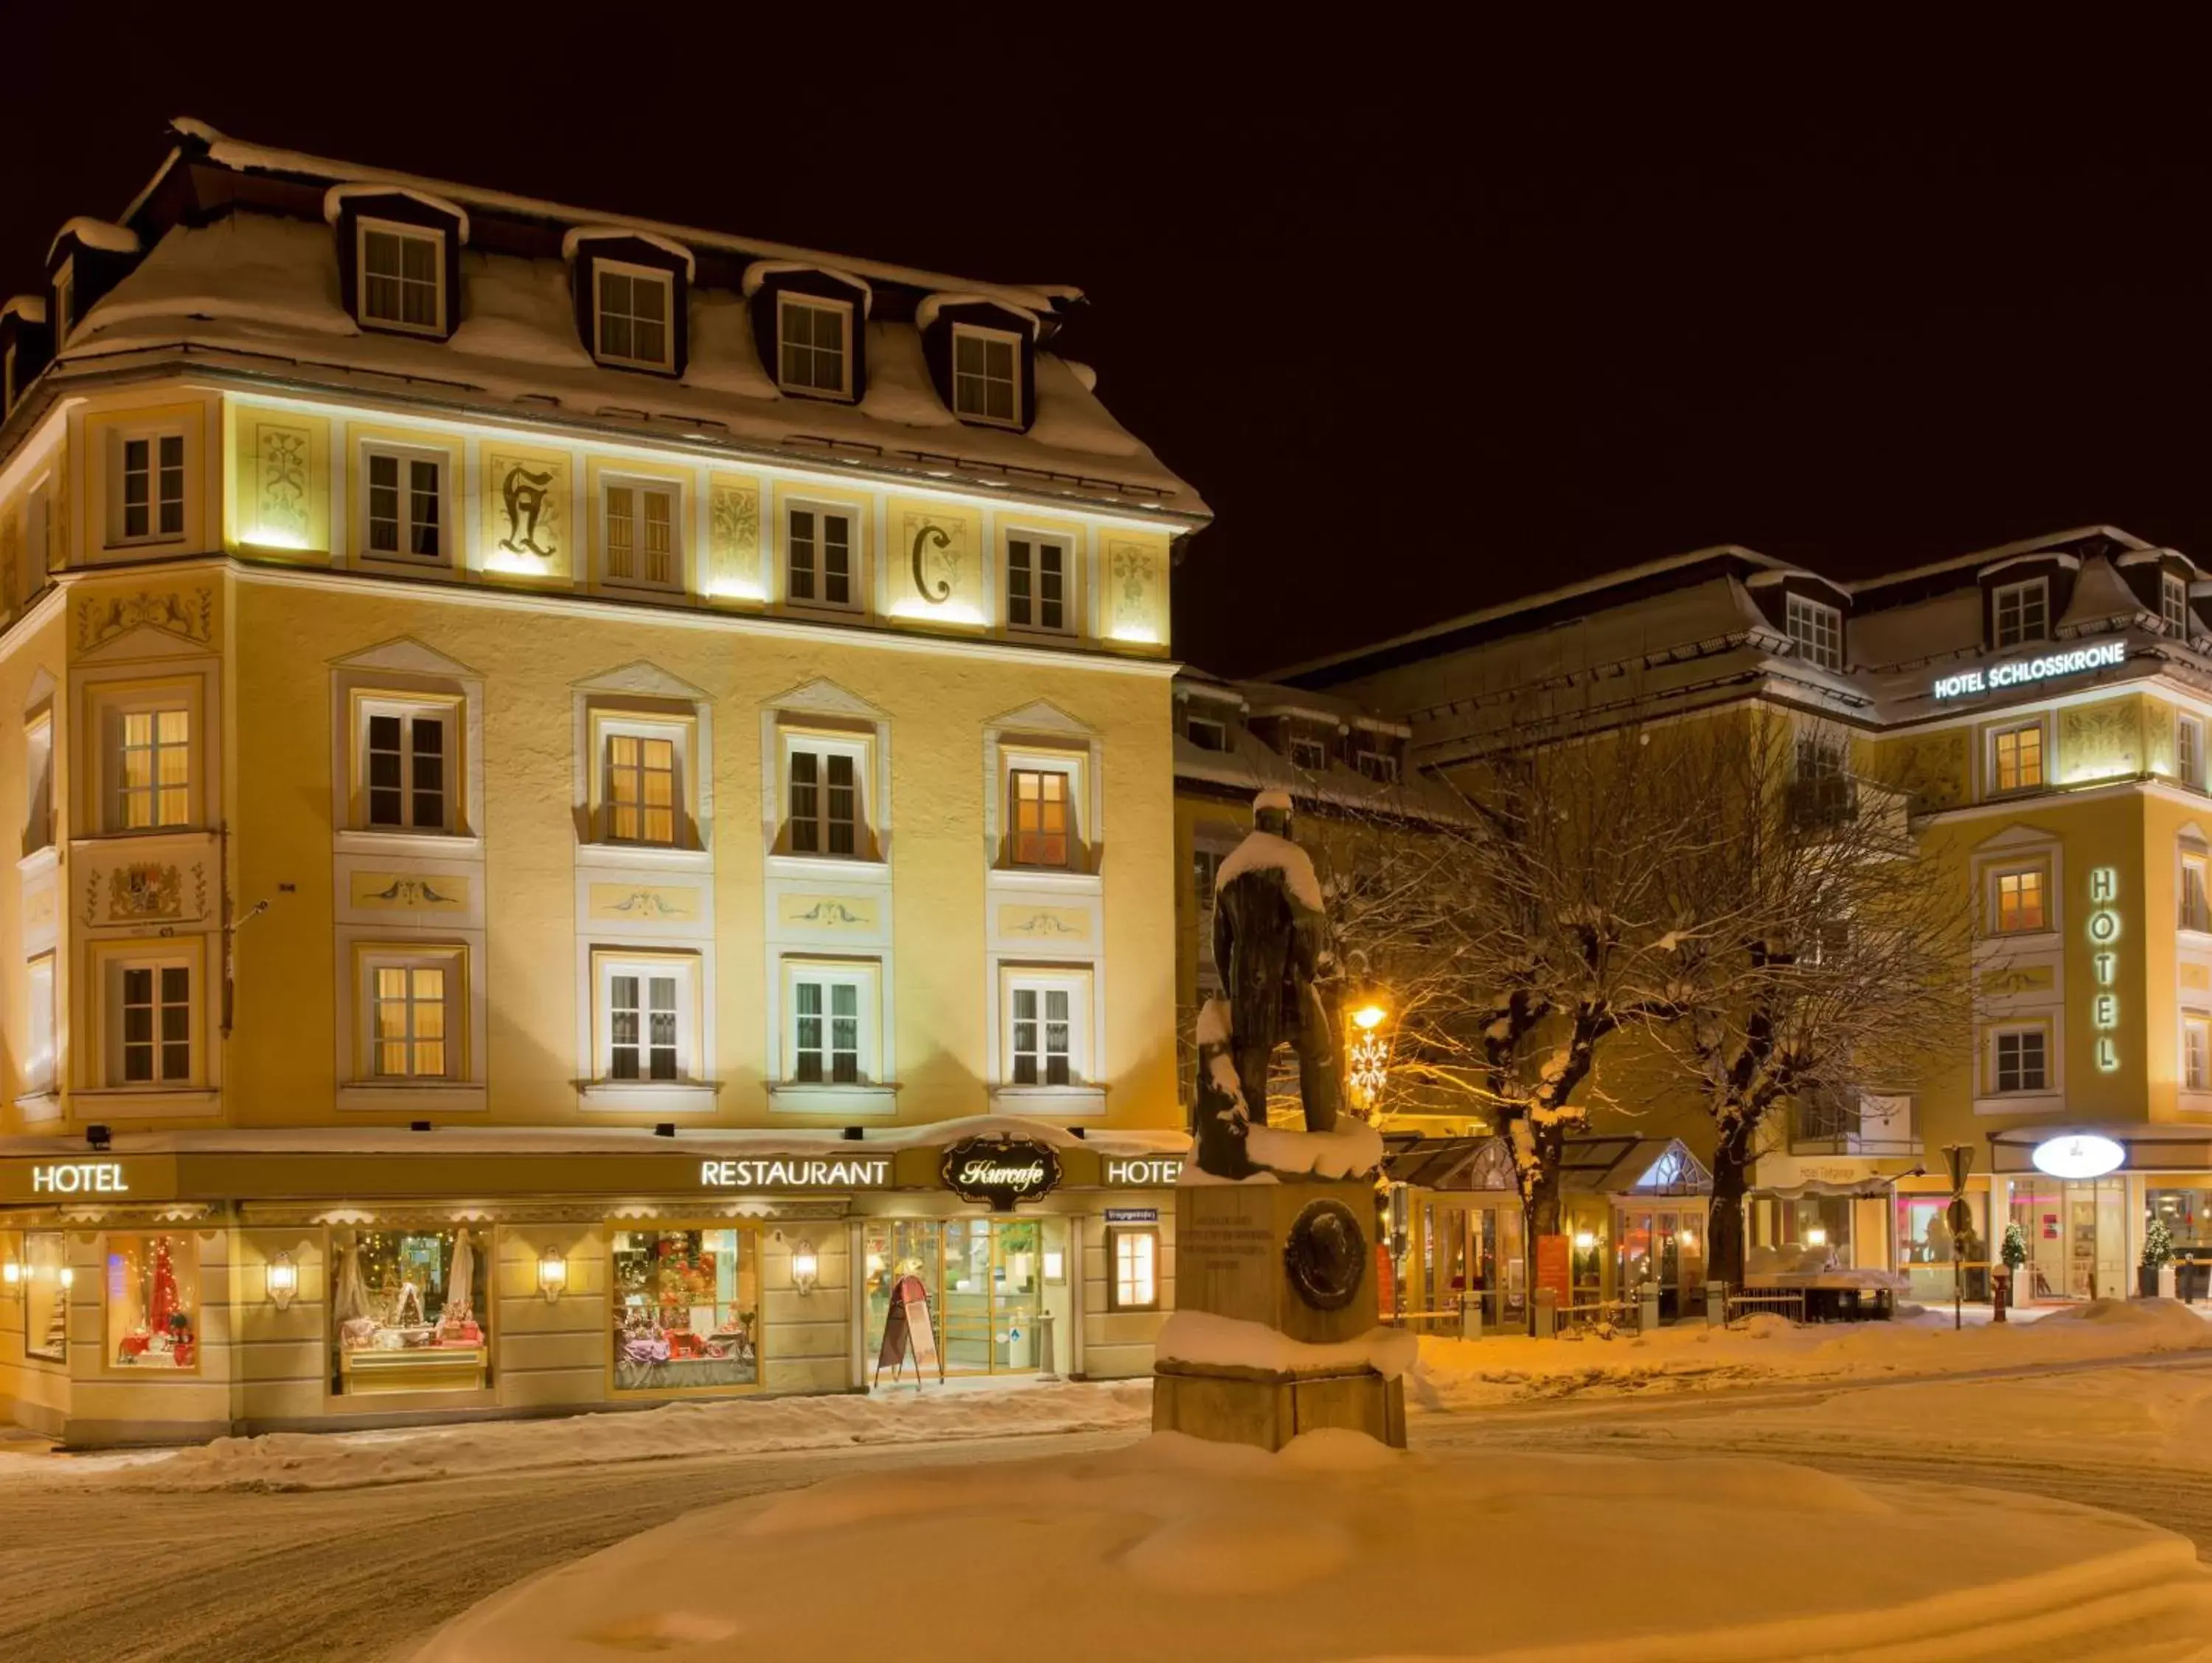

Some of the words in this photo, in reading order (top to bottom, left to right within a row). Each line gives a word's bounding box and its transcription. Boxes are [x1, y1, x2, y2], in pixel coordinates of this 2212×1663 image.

[1935, 672, 1985, 699] HOTEL
[1989, 643, 2125, 688] SCHLOSSKRONE
[2090, 868, 2116, 1069] HOTEL
[33, 1163, 129, 1193] HOTEL
[702, 1161, 889, 1185] RESTAURANT
[959, 1160, 1044, 1192] Kurcafe
